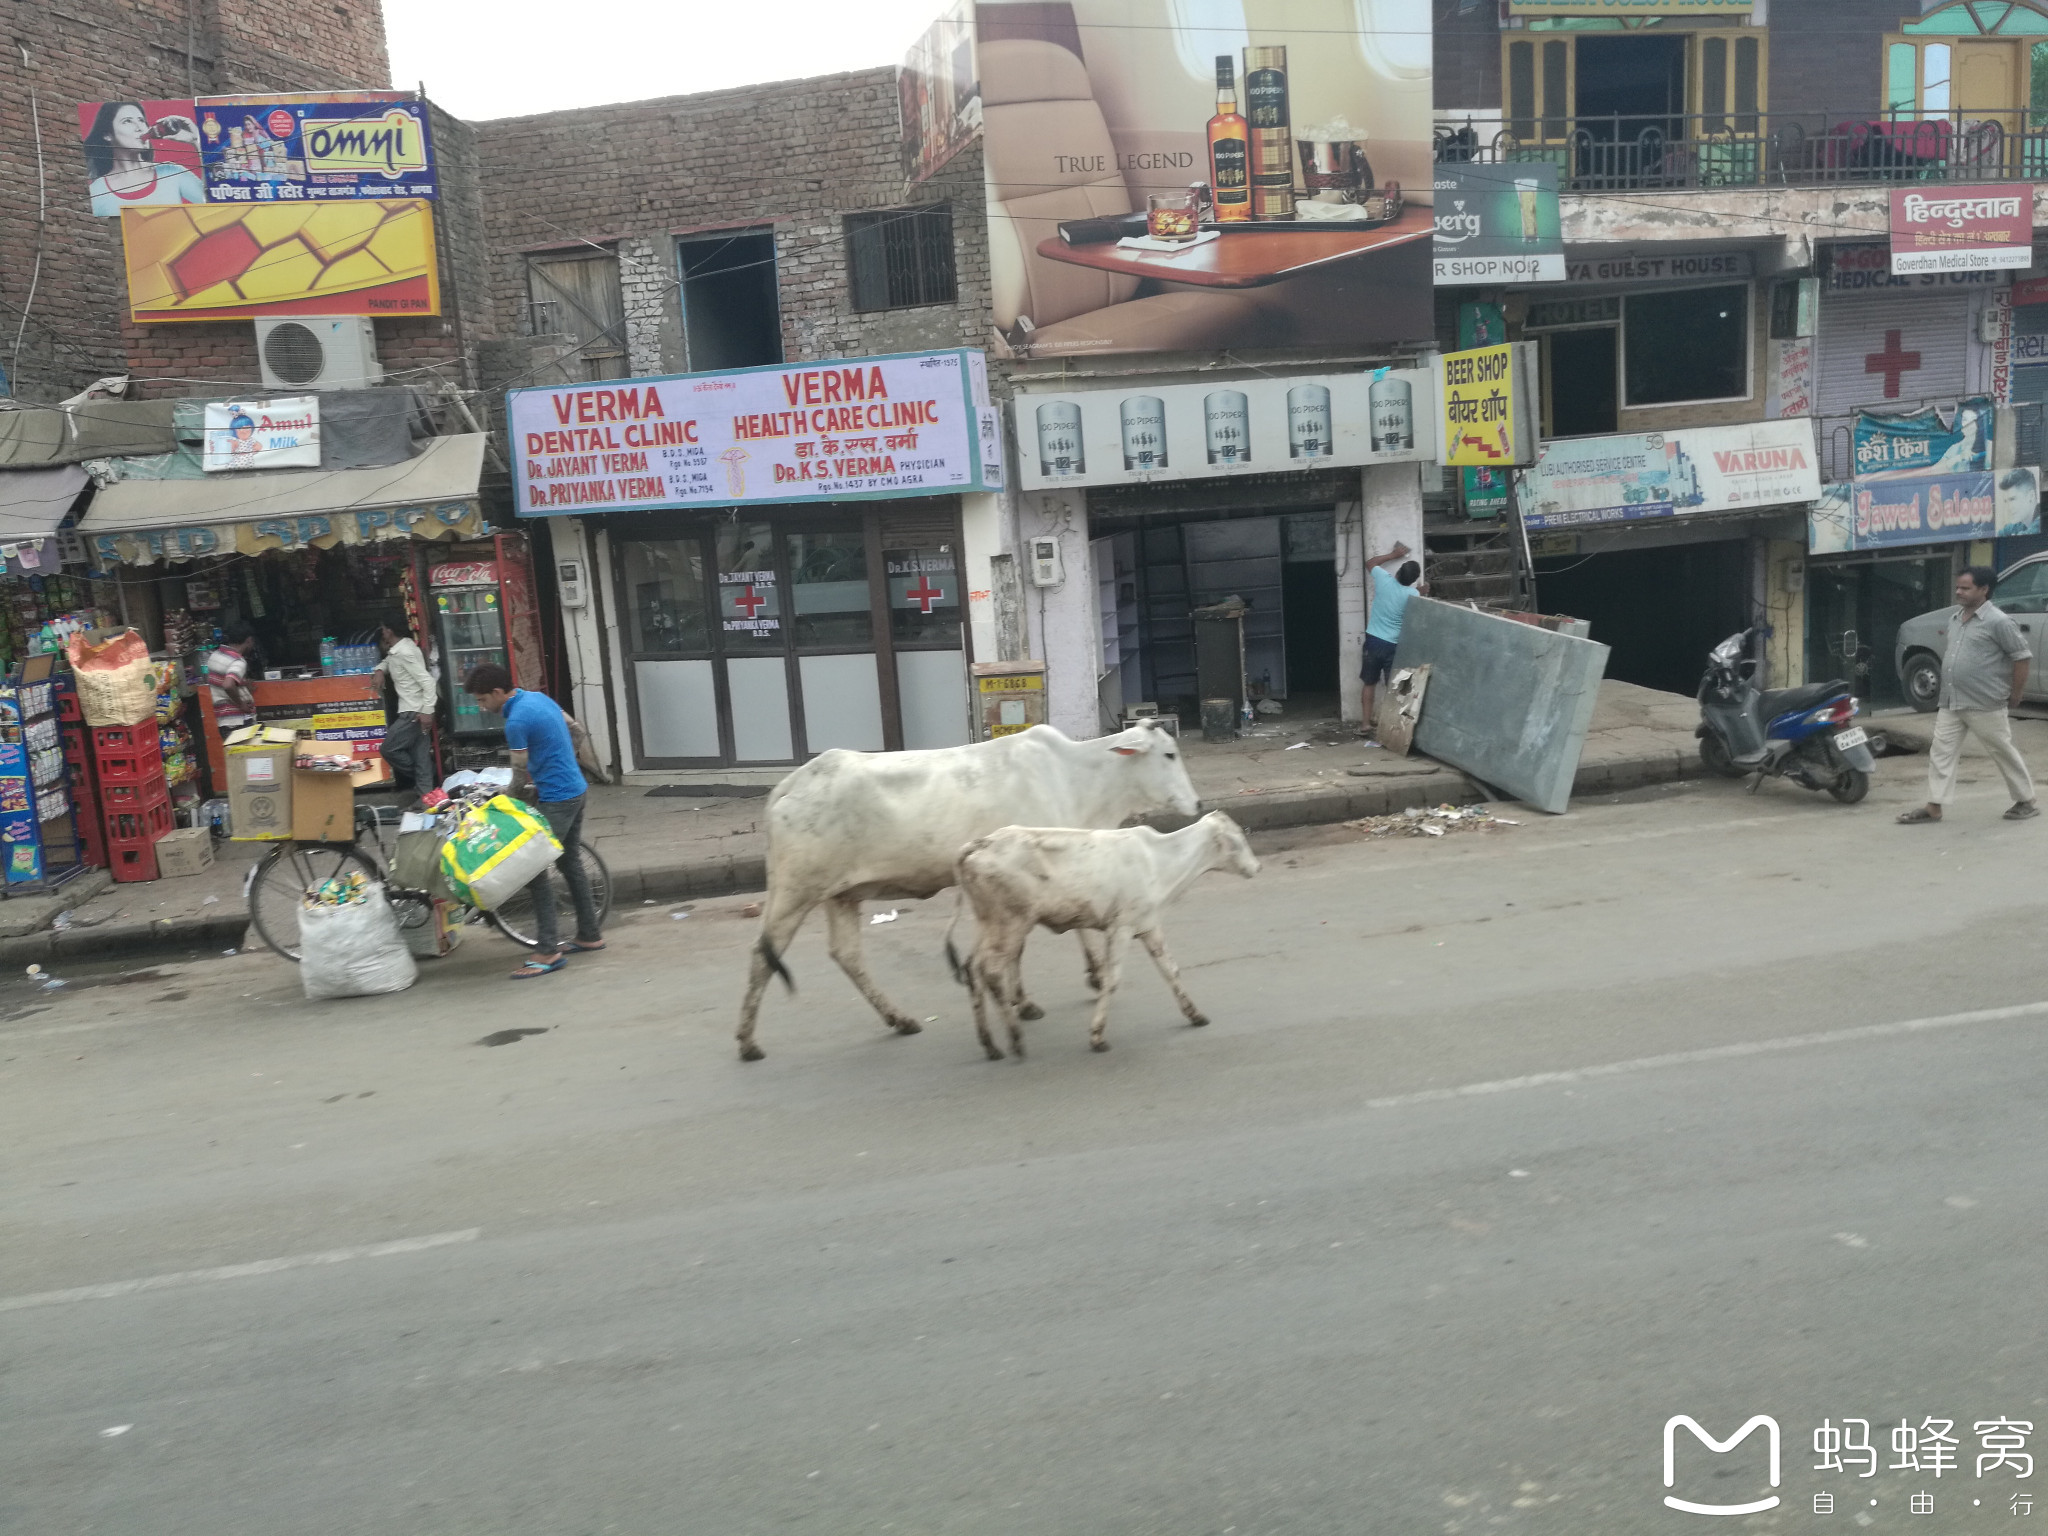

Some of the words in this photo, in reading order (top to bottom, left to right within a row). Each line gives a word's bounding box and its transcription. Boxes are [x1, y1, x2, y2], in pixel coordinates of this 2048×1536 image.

[1054, 154, 1105, 174] TRUE
[1116, 152, 1194, 171] LEGEND
[1225, 151, 1245, 159] PIPERS
[253, 182, 274, 199] जी
[276, 182, 304, 199] स्टोर
[1904, 194, 2021, 228] हिन्दुस्तान
[1452, 261, 1497, 276] SHOP
[1600, 260, 1664, 280] GUEST
[1672, 256, 1738, 275] HOUSE
[1897, 256, 1937, 271] Goverdhan
[1938, 254, 1968, 269] Medical
[1969, 253, 1989, 267] Store
[368, 299, 398, 309] PANDIT
[410, 299, 427, 309] PAN
[1447, 358, 1474, 386] BEER
[1477, 352, 1508, 382] SHOP
[782, 365, 890, 407] VERMA
[552, 386, 665, 426] VERMA
[1448, 391, 1479, 423] बीयर
[1481, 389, 1508, 422] शॉप
[257, 413, 313, 433] Amul
[734, 410, 808, 441] HEALTH
[810, 404, 865, 434] CARE
[866, 398, 939, 429] CLINIC
[269, 436, 299, 449] Milk
[526, 426, 621, 456] DENTAL
[623, 419, 699, 449] CLINIC
[1713, 448, 1808, 473] VARUNA
[1857, 440, 1889, 463] केश
[1893, 437, 1930, 460] किंग
[601, 451, 649, 474] VERMA
[900, 458, 945, 472] PHYSICIAN
[1557, 458, 1595, 475] AUTHORISED
[1596, 455, 1622, 472] SERVICE
[1623, 455, 1646, 469] CENTRE
[618, 475, 667, 500] VERMA
[868, 478, 878, 487] BY
[880, 477, 900, 487] CMO
[902, 474, 924, 484] AGRA
[1563, 510, 1600, 524] ELECTRICAL
[1601, 508, 1624, 520] WORKS
[1857, 490, 1921, 536] Jawed
[1927, 484, 1994, 531] Saloon
[754, 569, 776, 582] VERMA
[758, 619, 779, 629] VERMA
